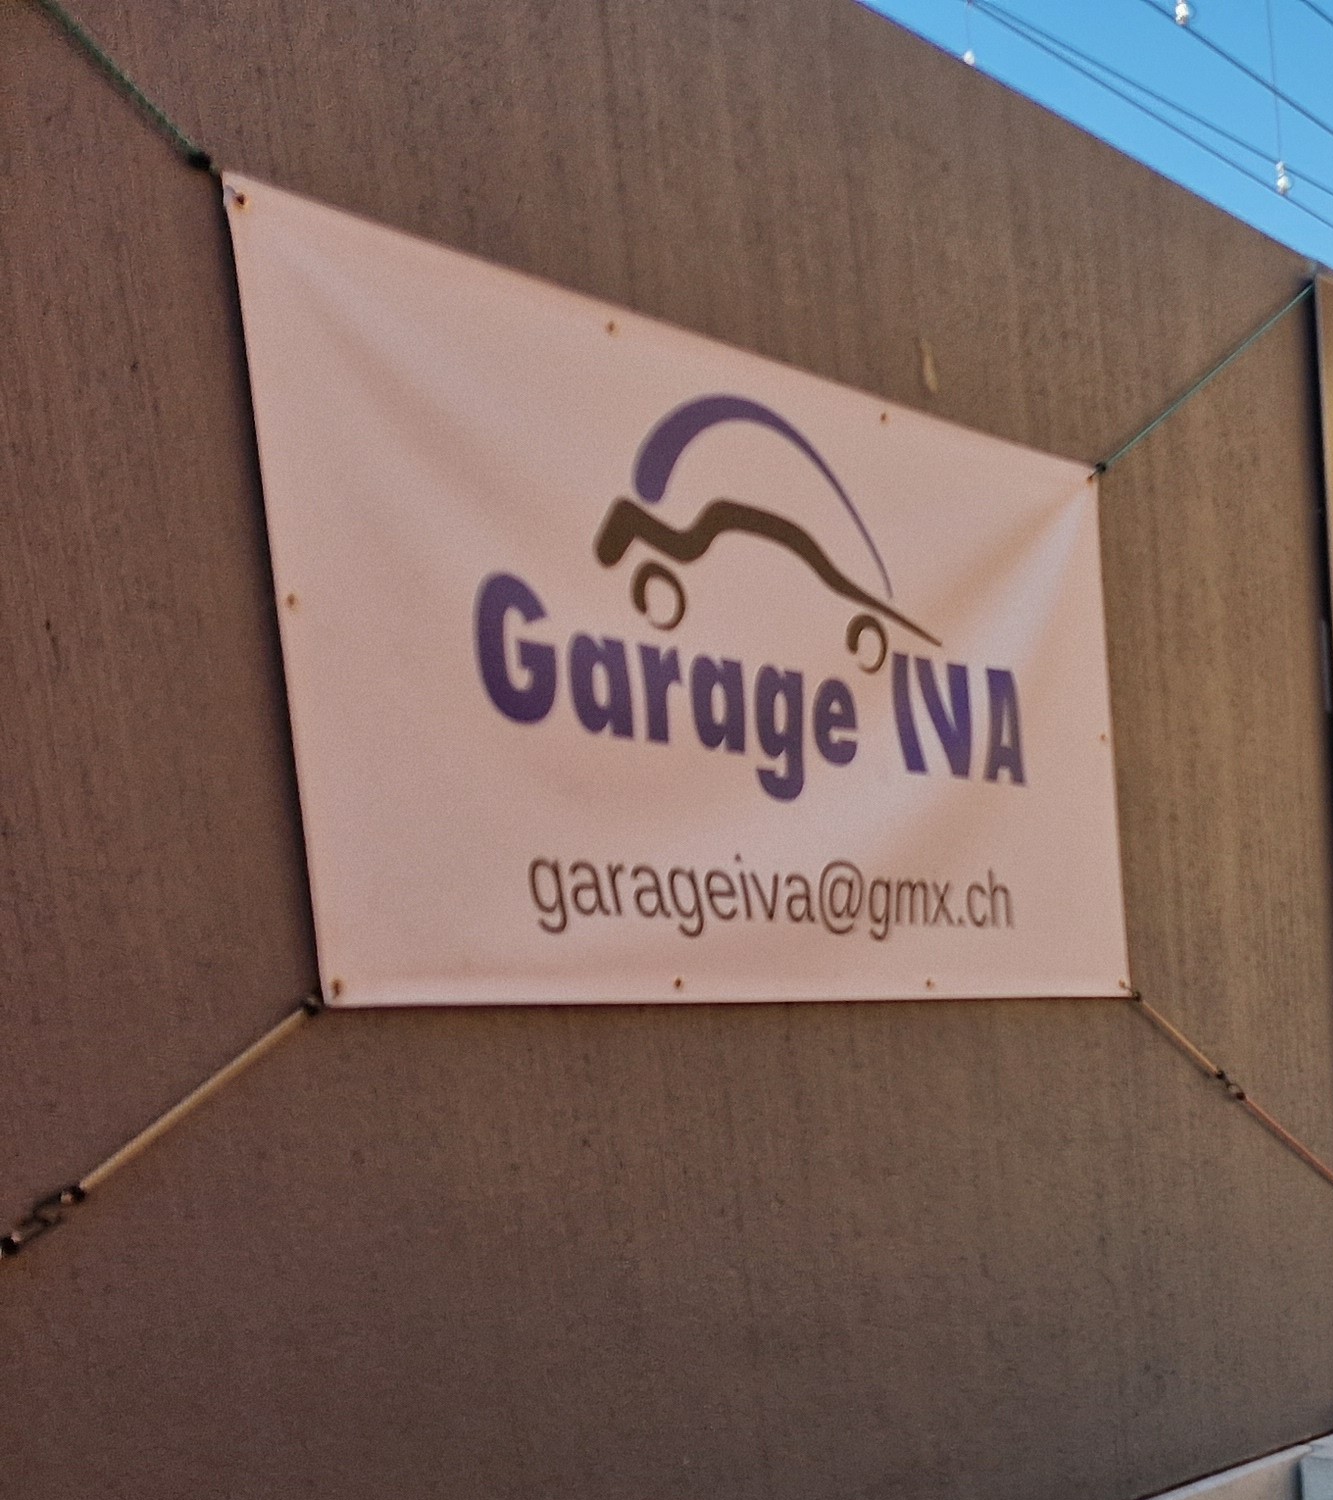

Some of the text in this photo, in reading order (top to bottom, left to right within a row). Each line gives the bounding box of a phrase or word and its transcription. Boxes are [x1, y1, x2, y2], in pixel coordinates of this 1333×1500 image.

[475, 571, 1028, 803] Garage IVA
[528, 855, 1016, 942] garageiva@gmx.ch
